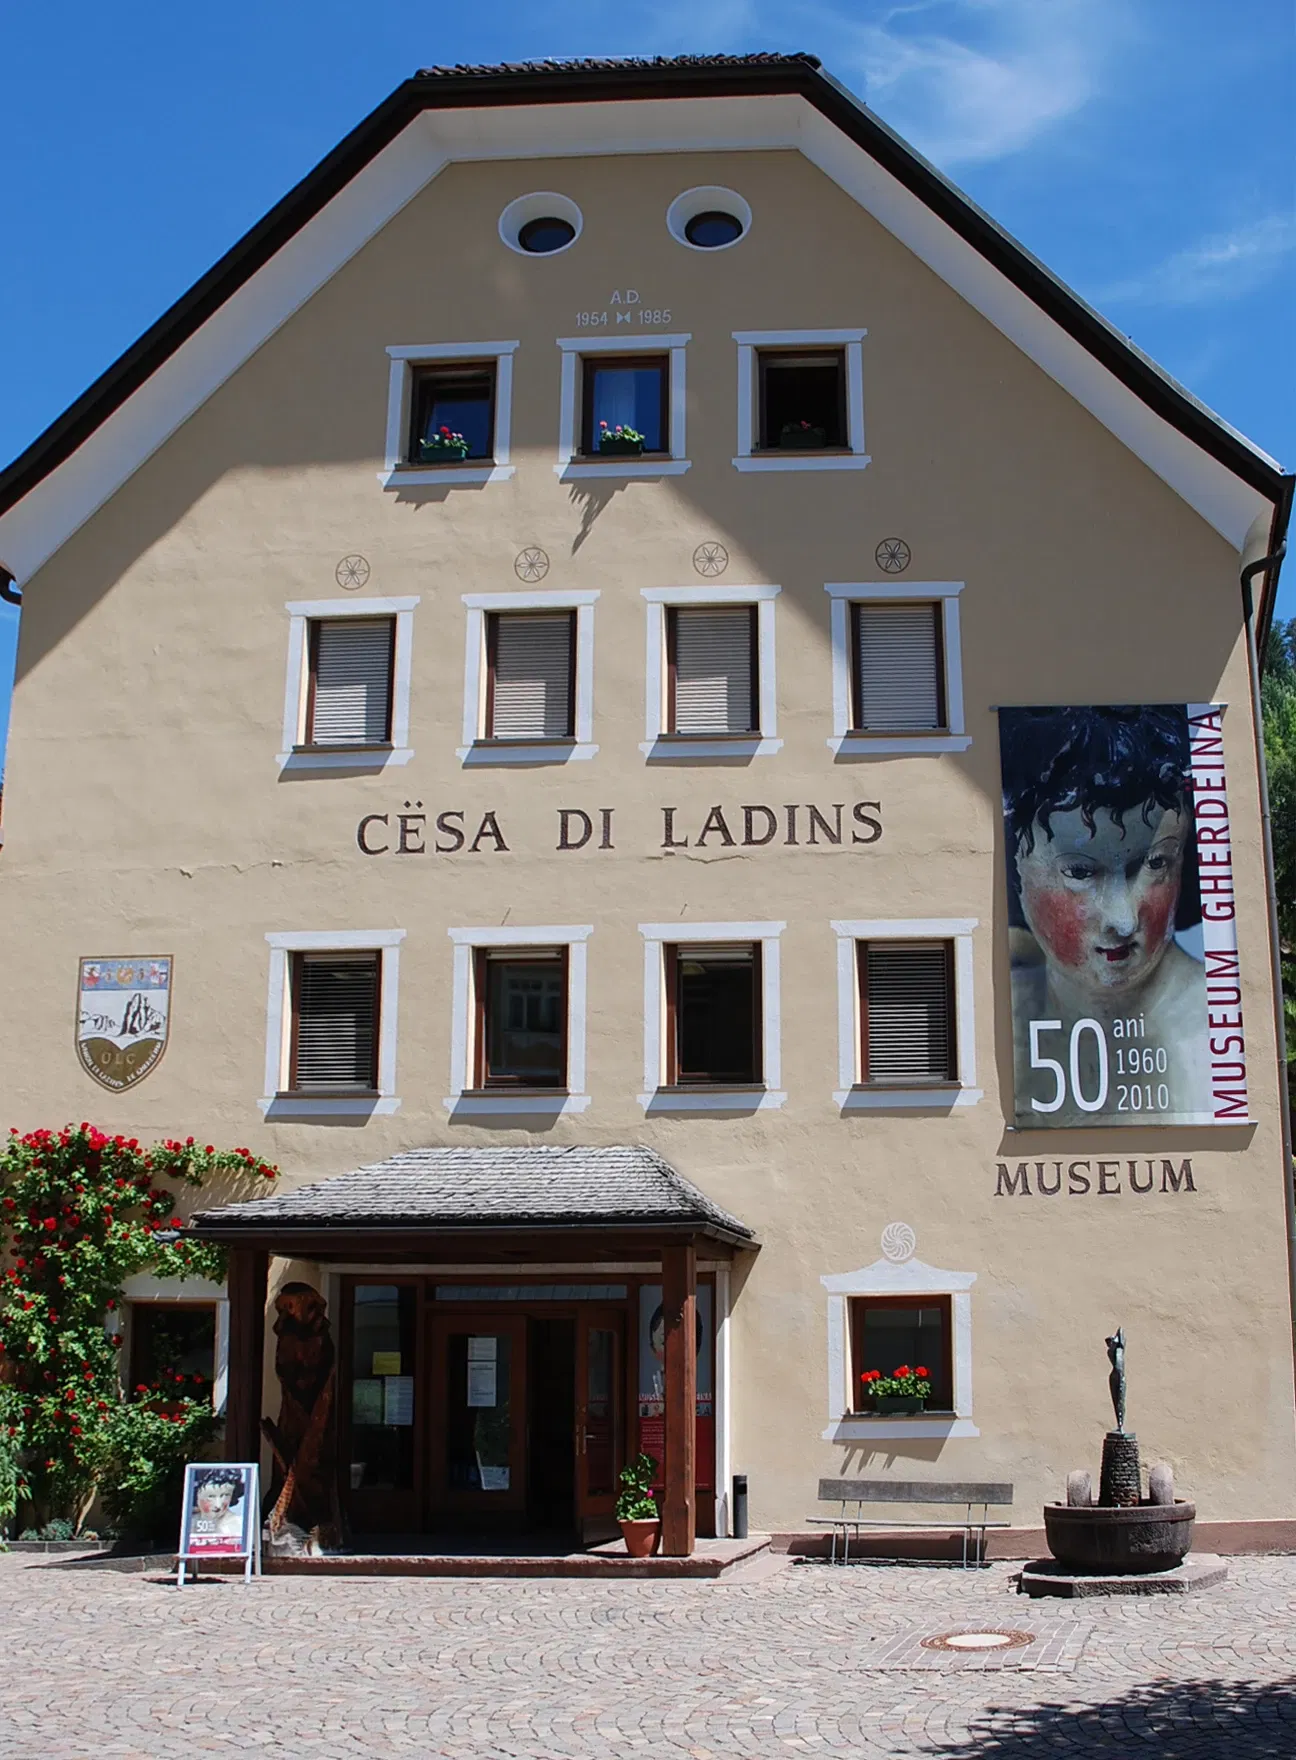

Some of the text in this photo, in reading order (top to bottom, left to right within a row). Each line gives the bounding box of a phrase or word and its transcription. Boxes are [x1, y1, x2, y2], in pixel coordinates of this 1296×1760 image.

[576, 309, 672, 326] 1954 1985
[357, 801, 883, 855] CËSA DI LADINS
[1113, 1013, 1145, 1038] ani
[1204, 950, 1249, 1118] MUSEUM
[1029, 1018, 1109, 1113] 50
[1116, 1047, 1168, 1074] 1960
[1117, 1084, 1169, 1111] 2010
[994, 1158, 1198, 1197] MUSEUM
